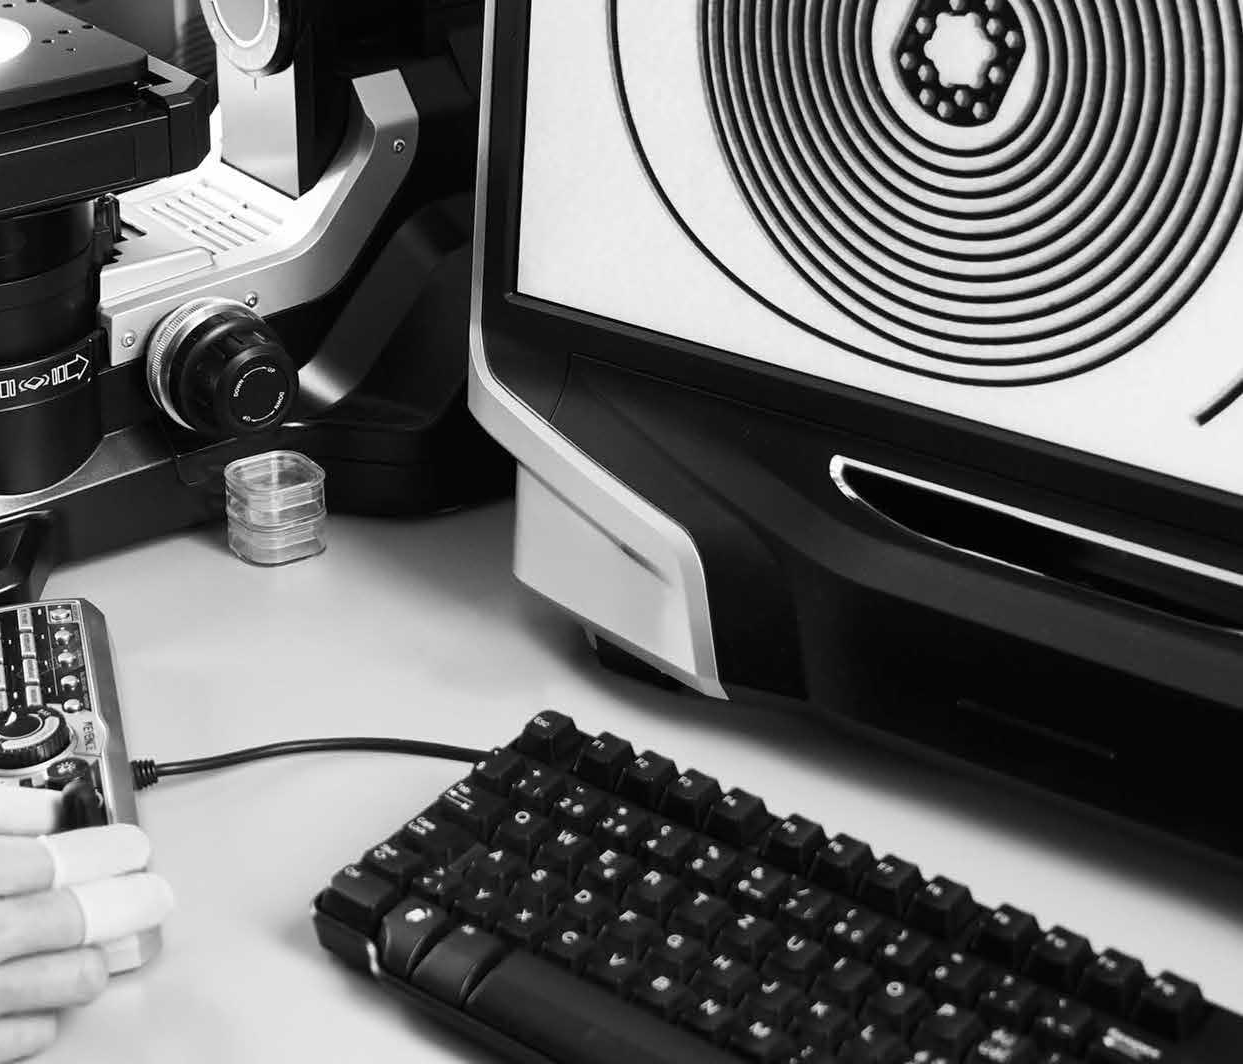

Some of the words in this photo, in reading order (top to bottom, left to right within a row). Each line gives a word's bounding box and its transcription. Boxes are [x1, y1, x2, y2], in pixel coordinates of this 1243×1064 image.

[267, 366, 276, 374] UP
[233, 378, 244, 397] DOWN
[274, 391, 285, 410] DOWN
[591, 739, 606, 751] F1
[635, 756, 650, 769] F2
[557, 829, 578, 846] W
[488, 849, 504, 863] A
[531, 868, 548, 883] S
[474, 888, 492, 901] Y
[573, 889, 593, 904] D
[692, 891, 709, 906] T
[515, 909, 533, 924] X
[737, 913, 756, 929] Z
[561, 930, 579, 945] C
[786, 935, 806, 952] U
[609, 952, 628, 967] V
[885, 981, 905, 997] O
[700, 998, 721, 1015] N
